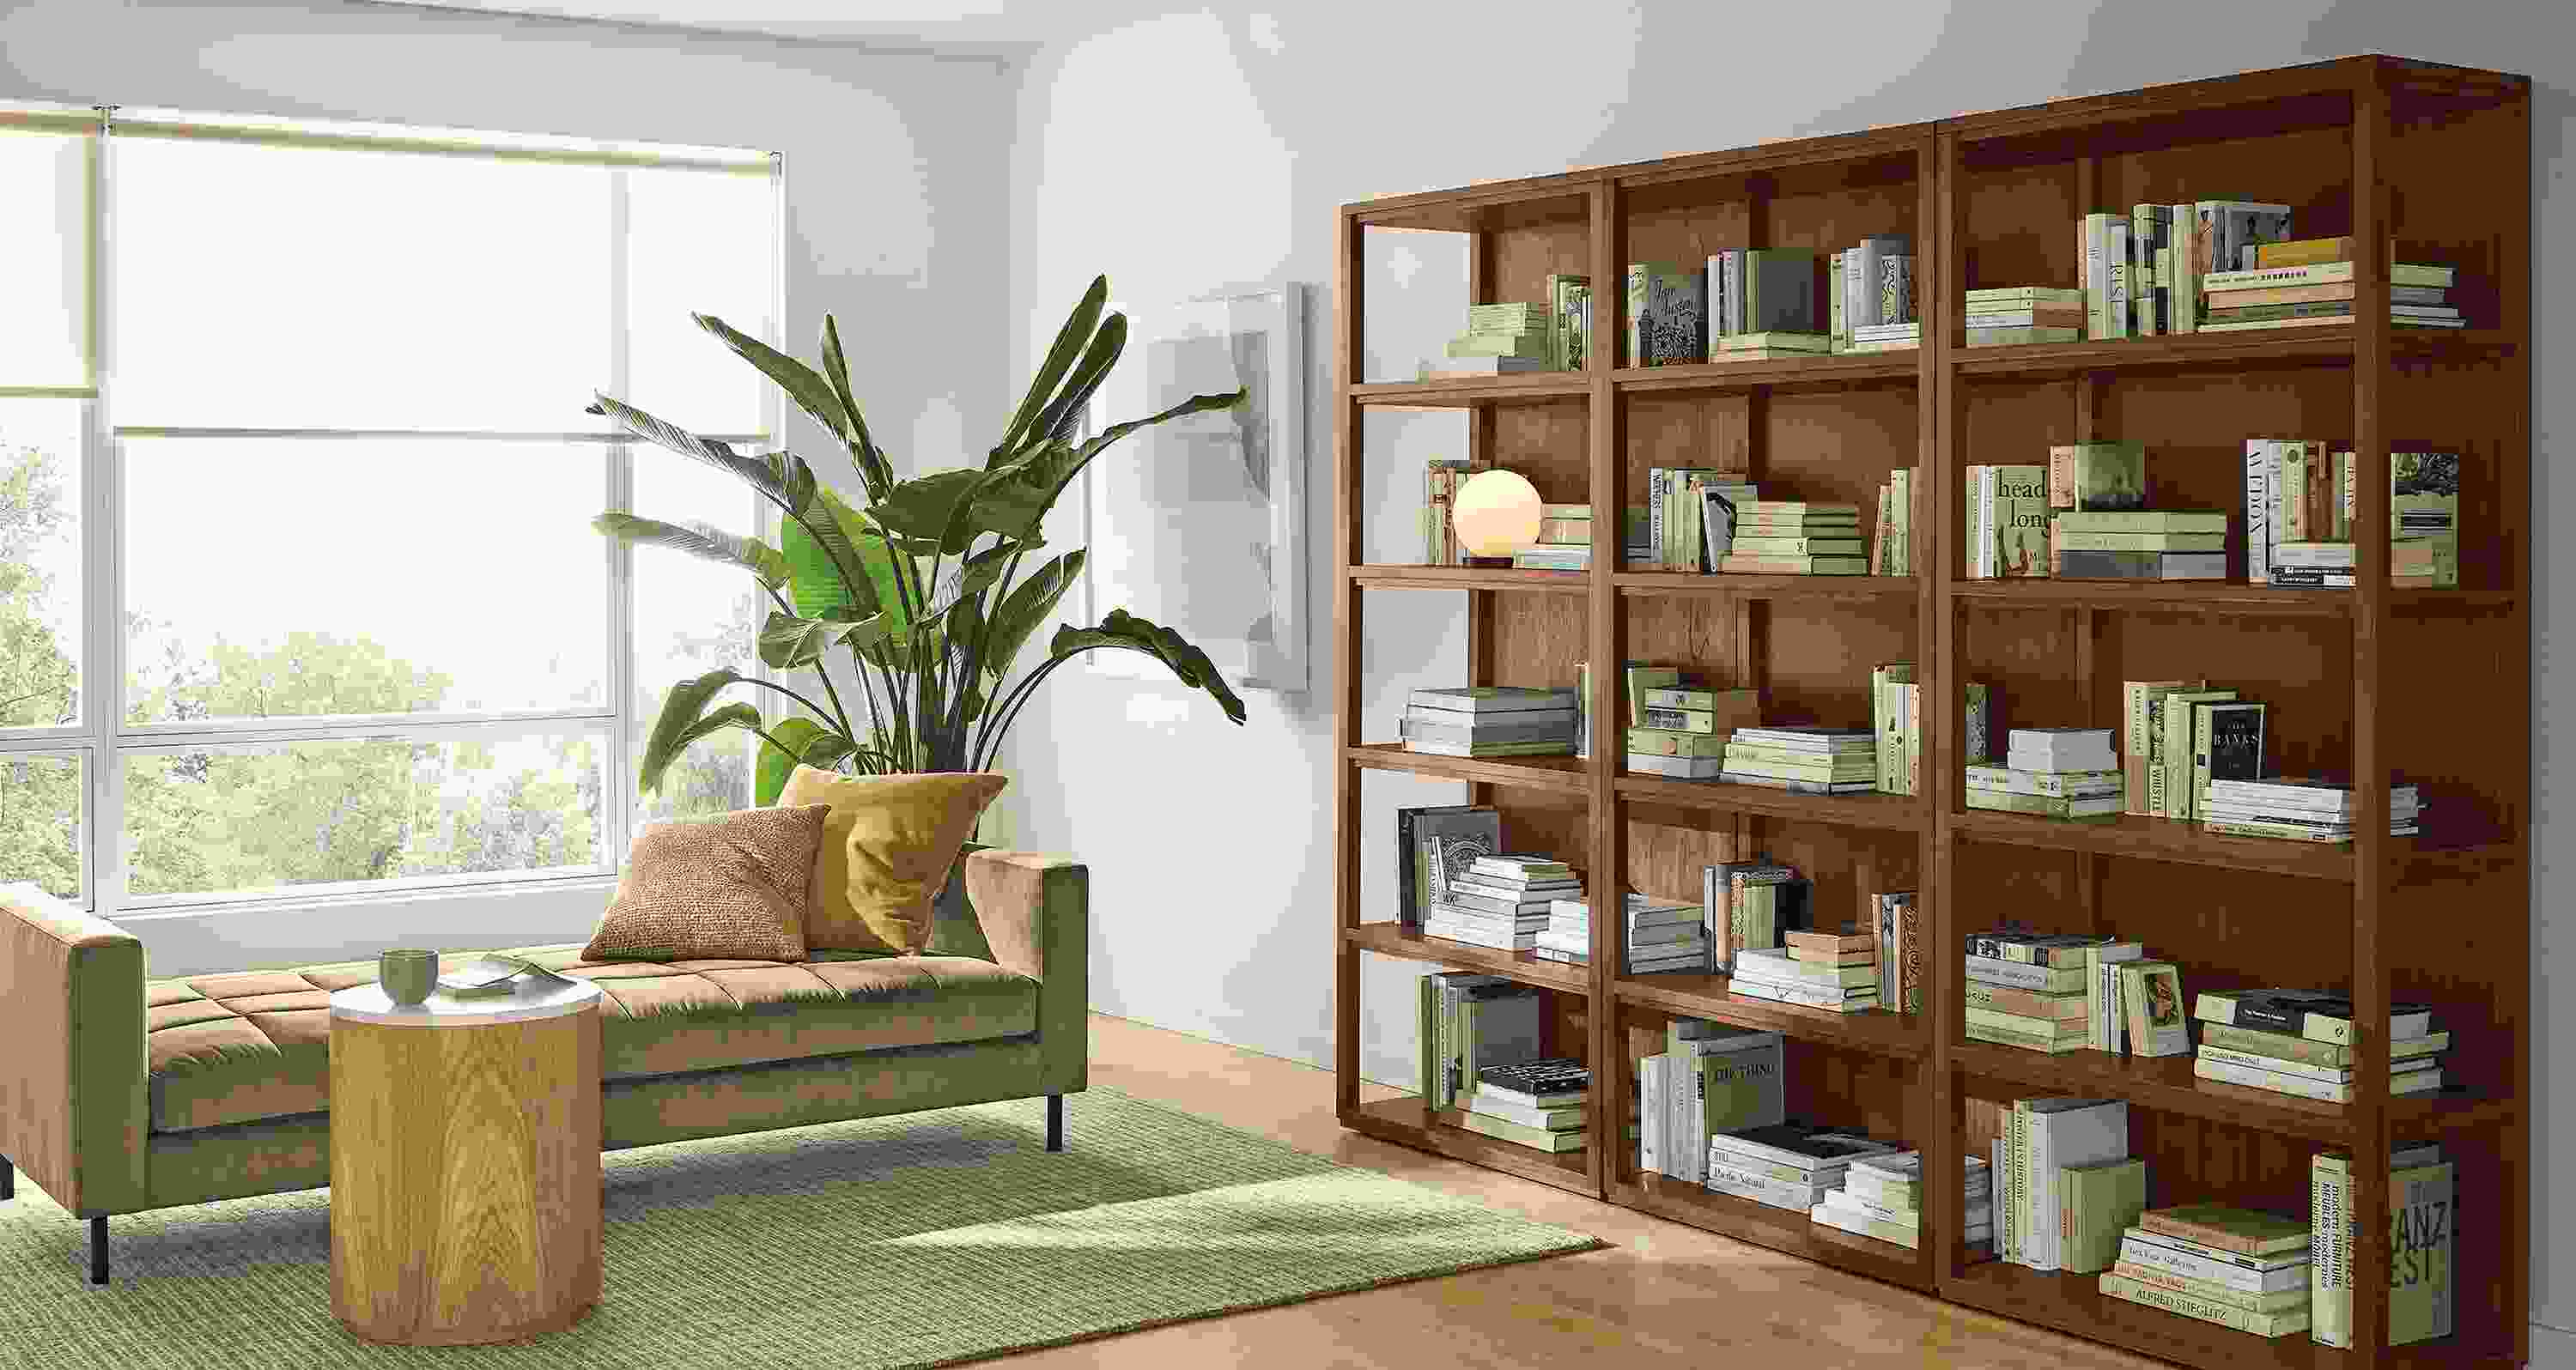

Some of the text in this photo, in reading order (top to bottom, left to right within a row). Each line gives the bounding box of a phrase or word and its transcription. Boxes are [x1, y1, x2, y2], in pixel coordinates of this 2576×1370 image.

[1997, 466, 2048, 498] head
[2321, 1183, 2331, 1229] MEUBLES
[2331, 1185, 2343, 1288] modern FURNITURE
[2136, 1288, 2227, 1320] ALFRED STIEGLITZ
